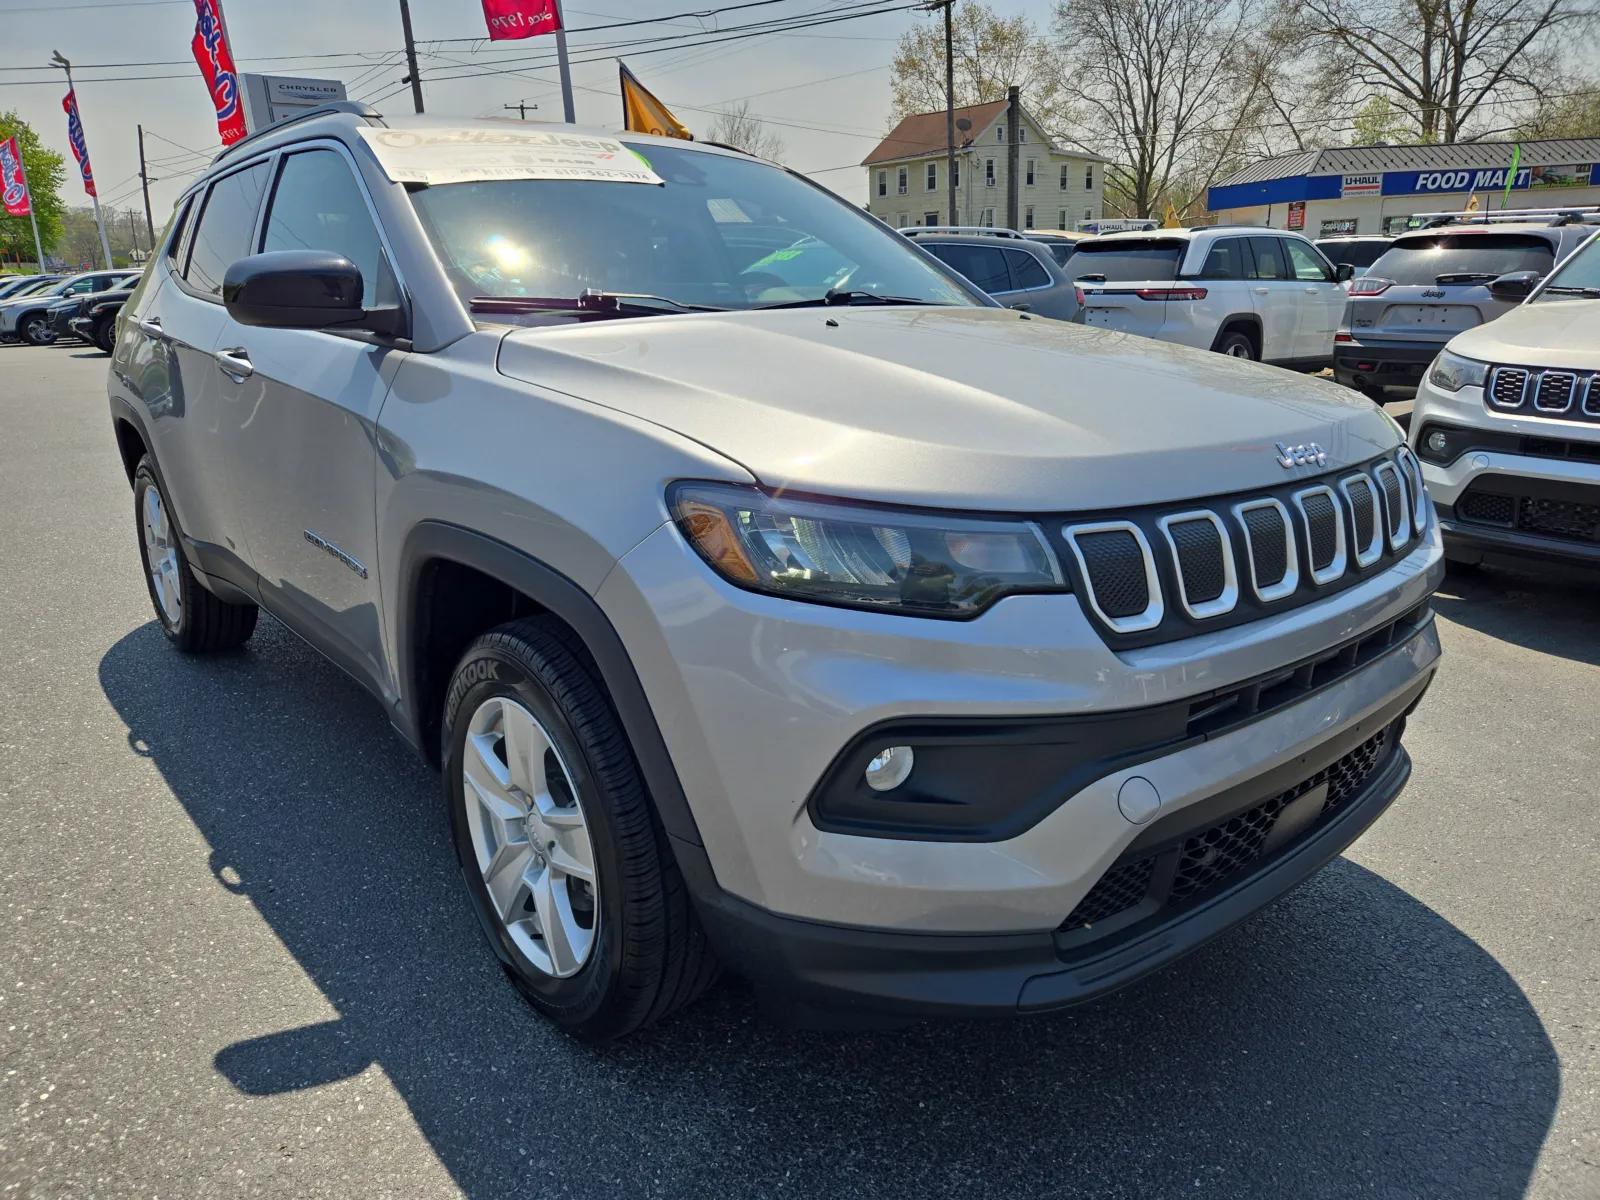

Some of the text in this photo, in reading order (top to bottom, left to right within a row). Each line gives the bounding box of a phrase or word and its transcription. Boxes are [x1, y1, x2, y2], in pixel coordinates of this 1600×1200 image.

[278, 84, 337, 93] CHRYSLER
[540, 134, 620, 153] Jeep
[554, 168, 651, 180] 610-562-5174
[1415, 171, 1469, 190] FOOD
[1420, 289, 1446, 299] Jeep
[1275, 442, 1326, 469] Jeep
